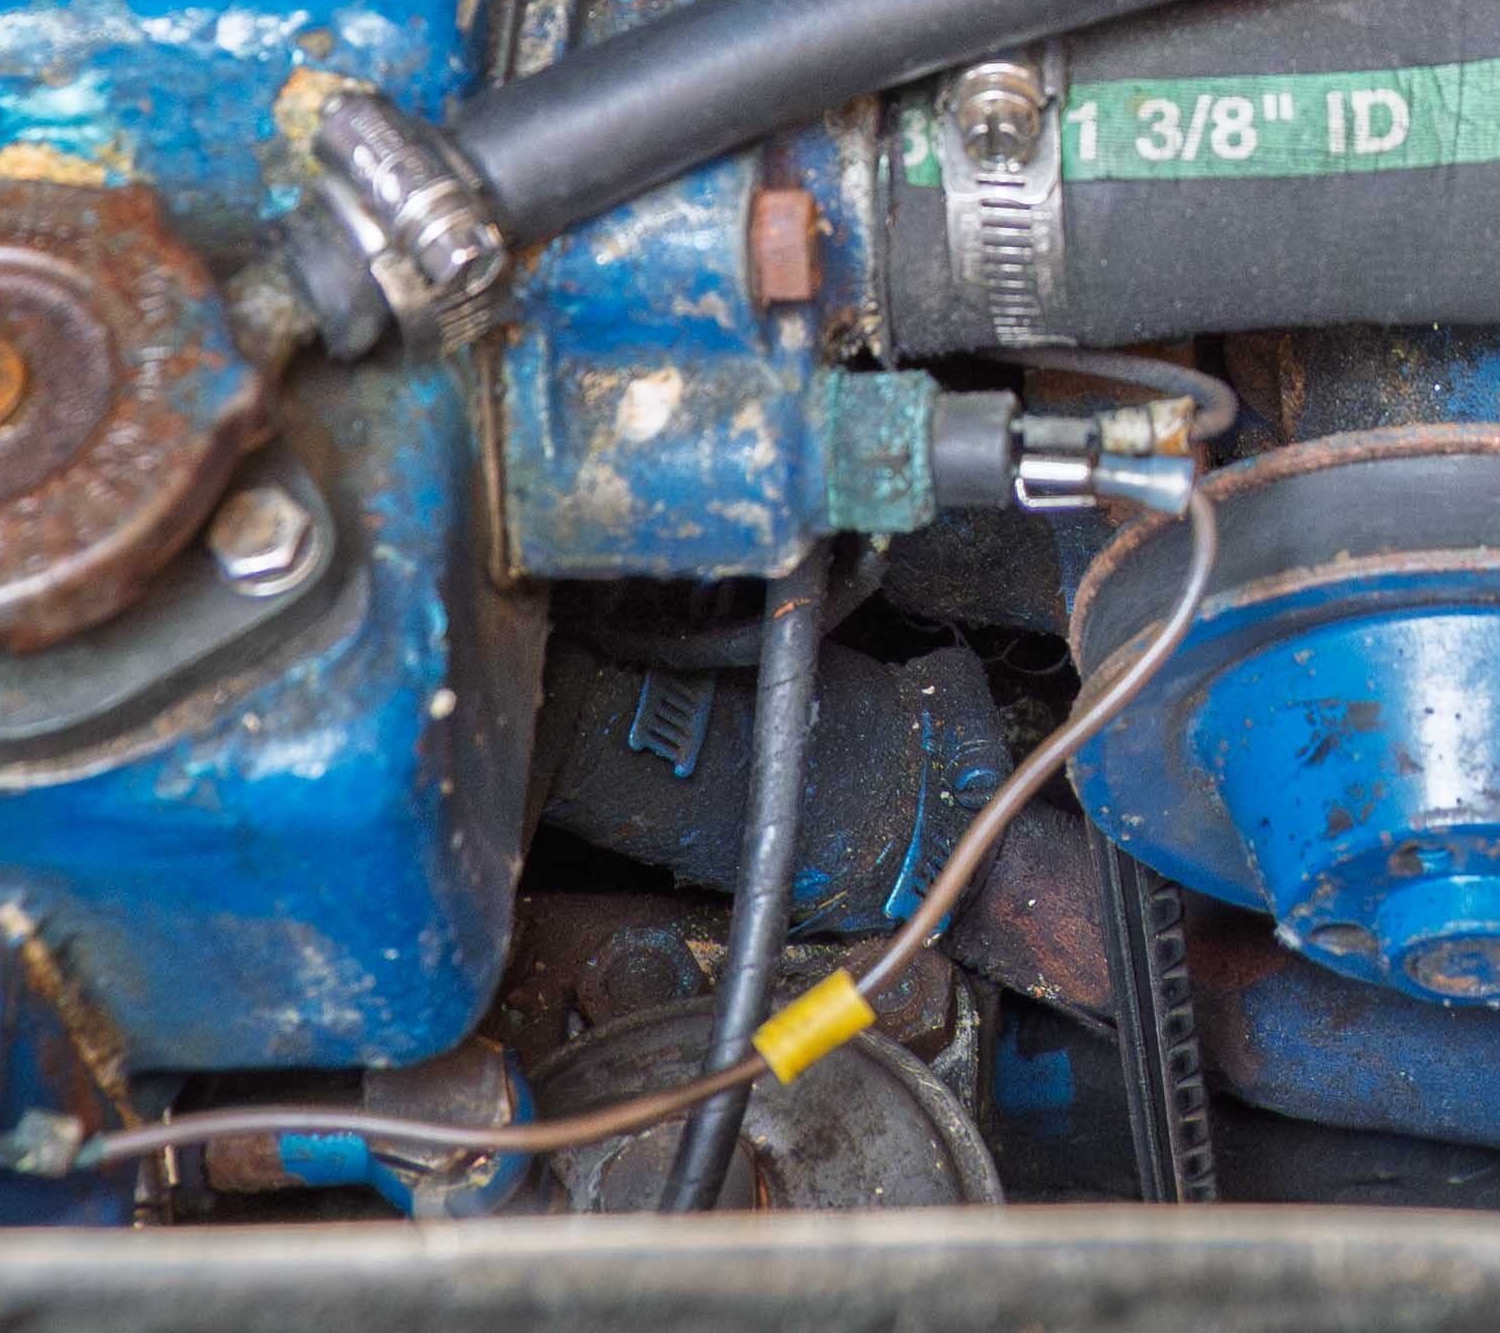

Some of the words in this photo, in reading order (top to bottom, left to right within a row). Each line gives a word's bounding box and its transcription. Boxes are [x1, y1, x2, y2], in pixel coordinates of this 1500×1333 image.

[1065, 101, 1099, 161] 1
[1134, 93, 1294, 163] 3/8"
[1326, 88, 1411, 156] ID
